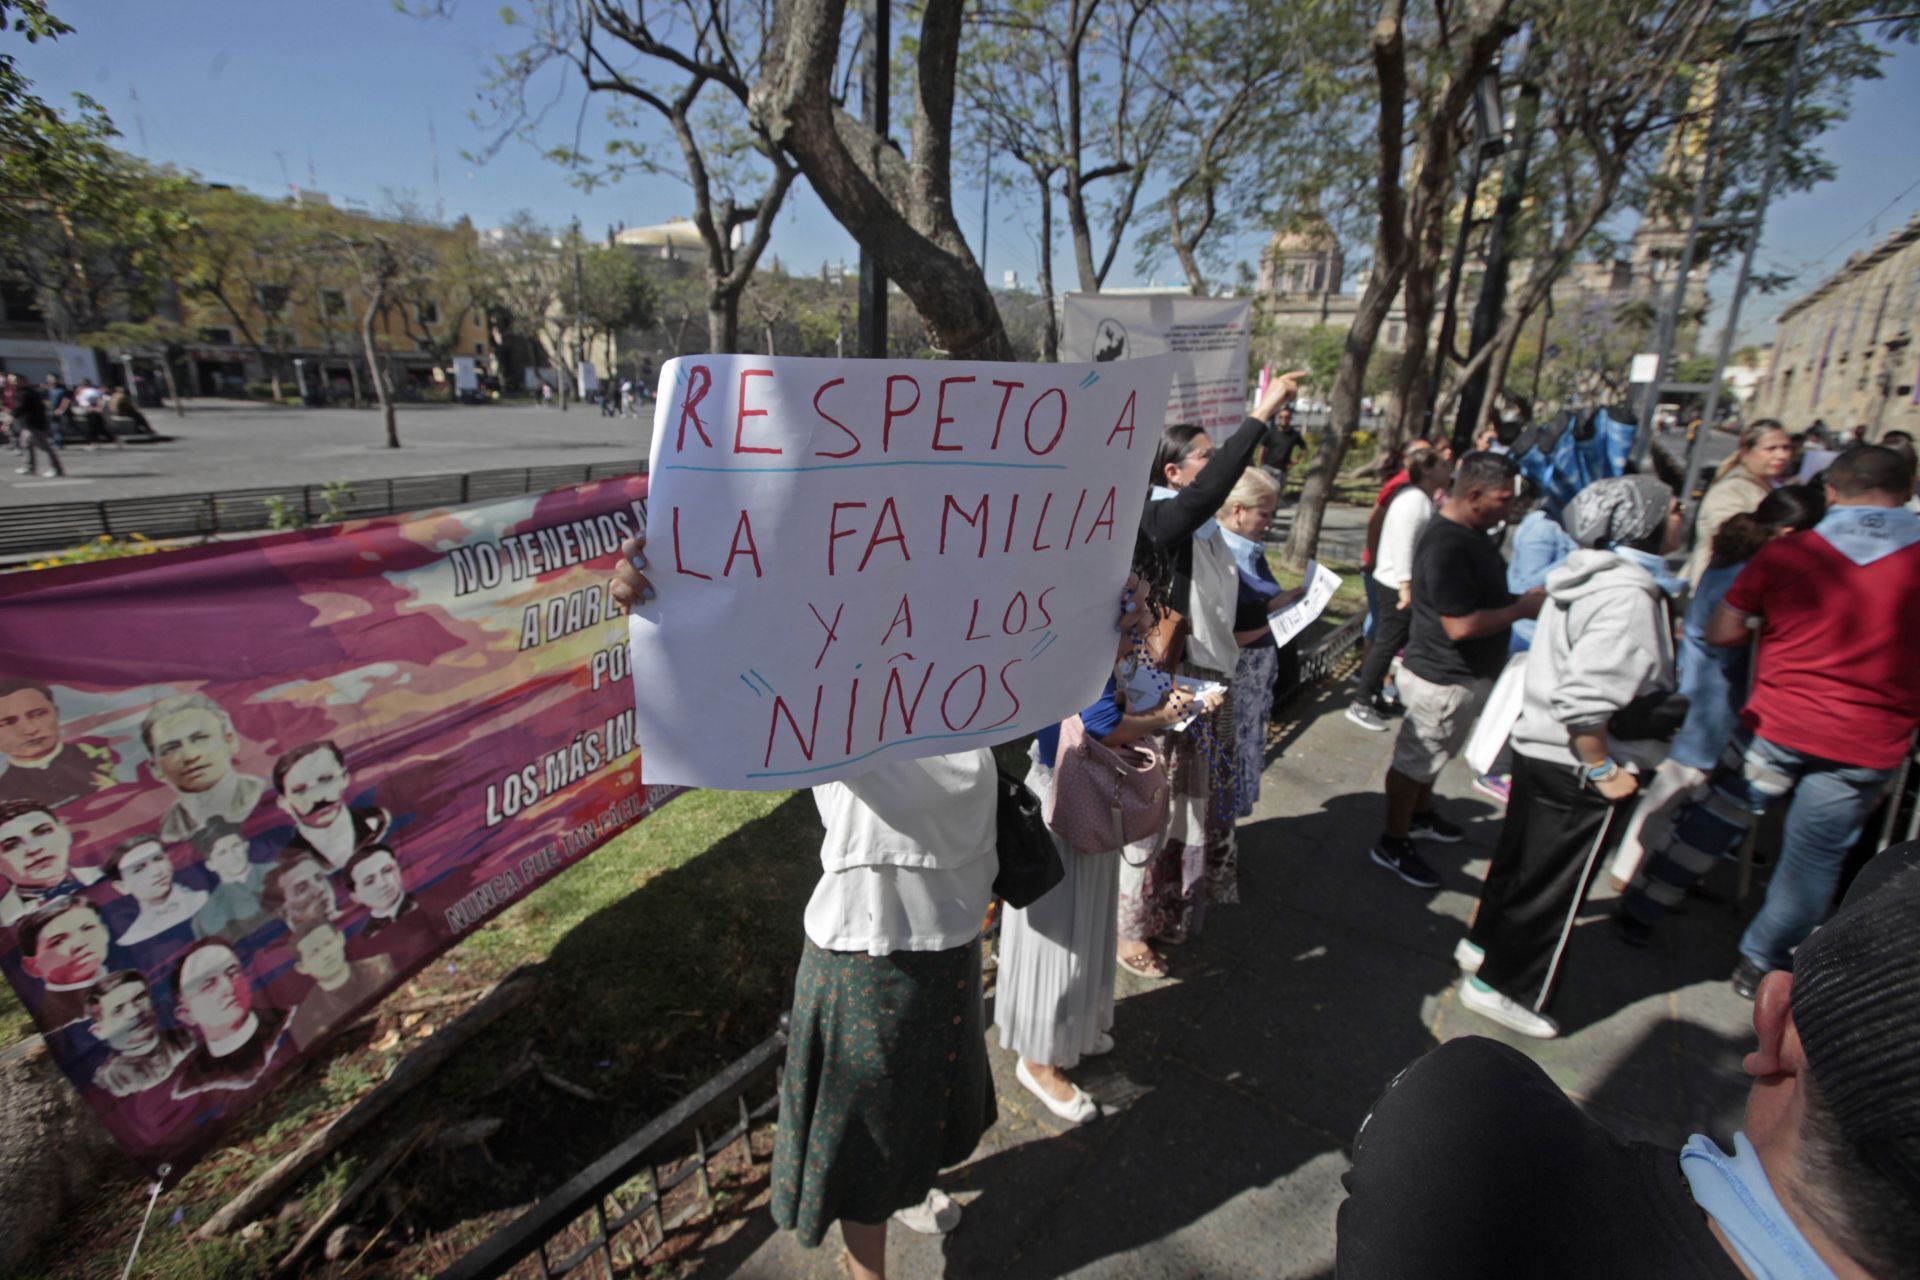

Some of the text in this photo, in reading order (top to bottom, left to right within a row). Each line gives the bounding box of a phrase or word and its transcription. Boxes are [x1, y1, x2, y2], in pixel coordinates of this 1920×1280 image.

[1106, 389, 1137, 450] A
[449, 541, 502, 597] NO
[500, 511, 634, 582] TENEMOS
[673, 506, 763, 581] LA
[827, 486, 1117, 576] FAMILIA
[518, 603, 541, 652] A
[546, 585, 602, 643] DAR
[808, 586, 1056, 668] Y A LOS
[485, 708, 641, 829] LOS MÁS IN
[443, 870, 522, 935] NUNCA
[519, 842, 562, 884] FUE
[561, 820, 599, 858] TAN
[597, 794, 643, 835] FÁCIL
